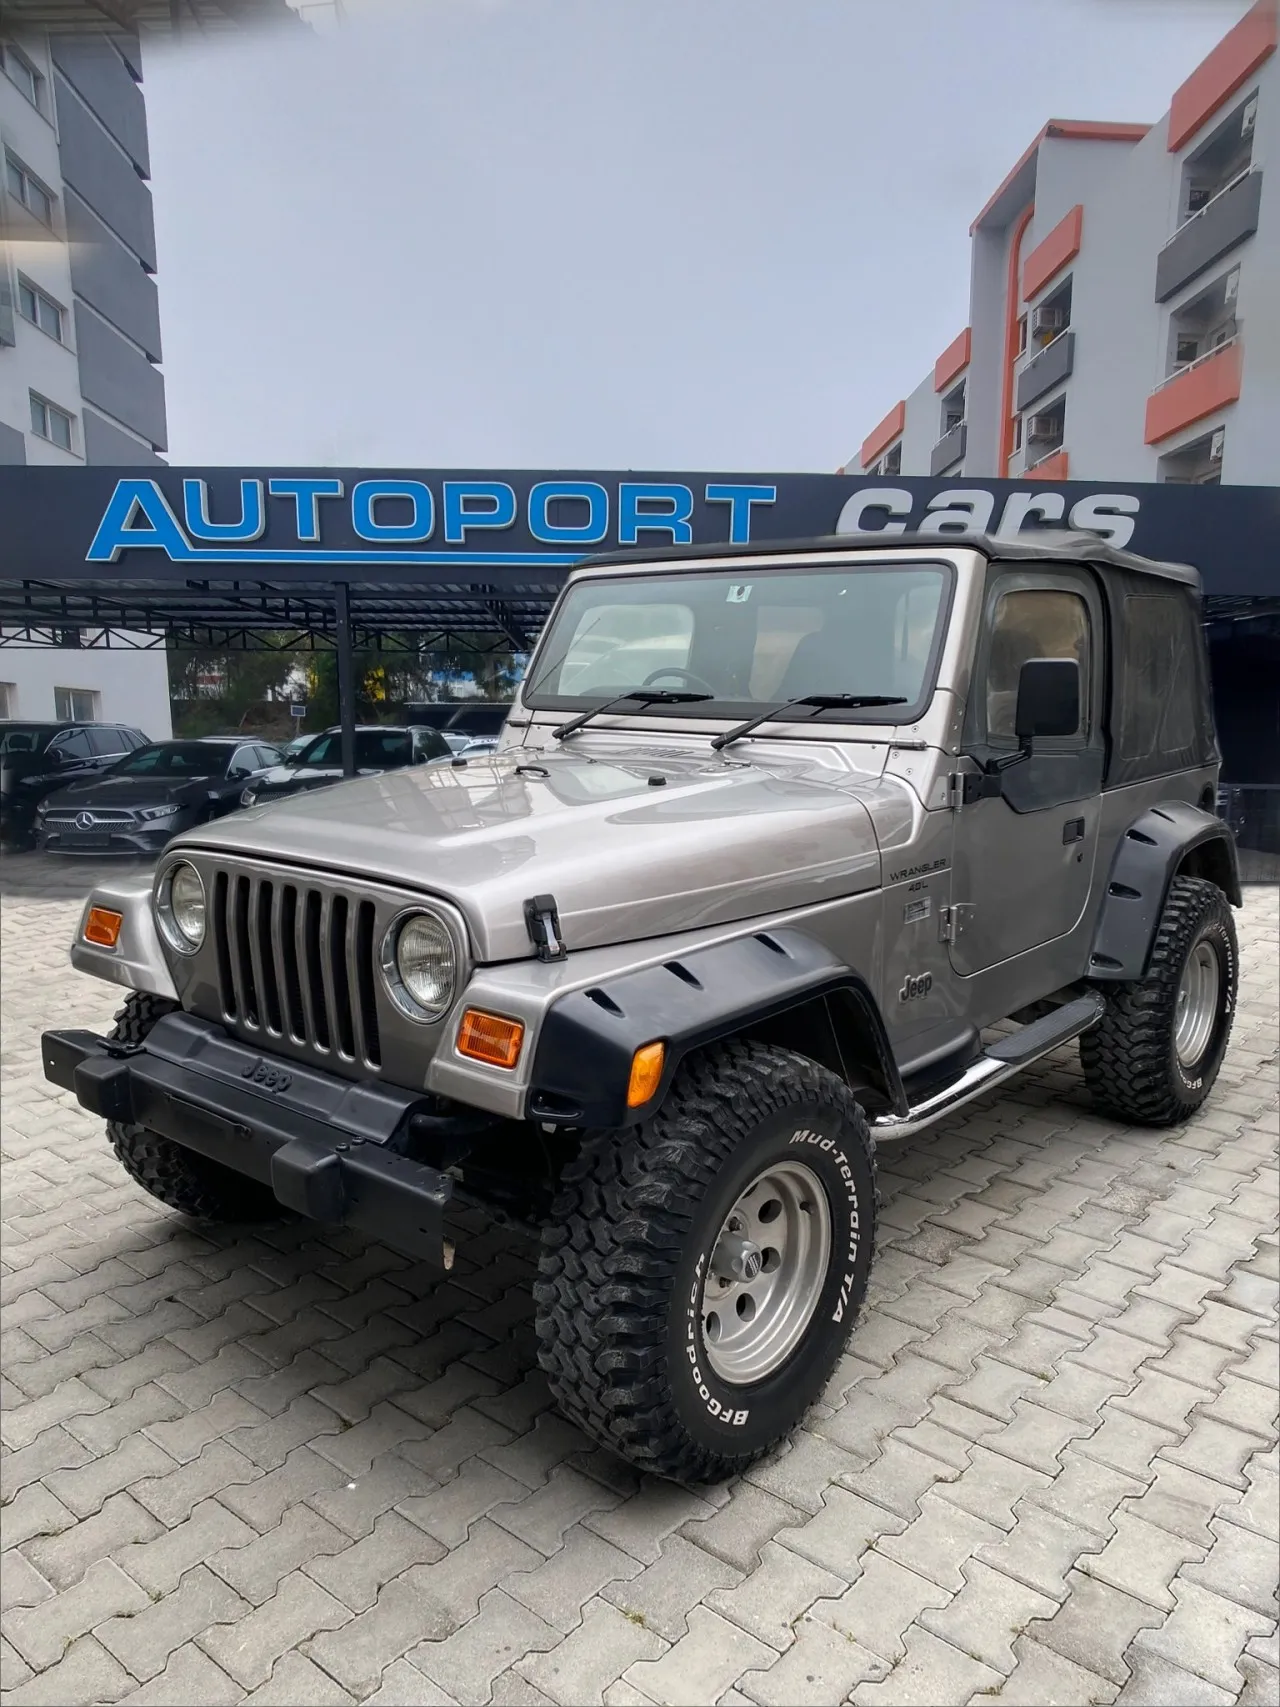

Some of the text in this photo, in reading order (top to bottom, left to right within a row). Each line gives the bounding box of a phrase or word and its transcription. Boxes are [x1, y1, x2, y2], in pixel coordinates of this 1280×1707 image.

[85, 478, 1140, 562] AUTOPORT cars
[889, 858, 947, 881] WRANGLER
[899, 971, 932, 1002] Jeep
[241, 1056, 293, 1095] Jeep
[788, 1129, 861, 1323] Mud-Terrain T/A
[686, 1252, 750, 1426] BFGoodrich
